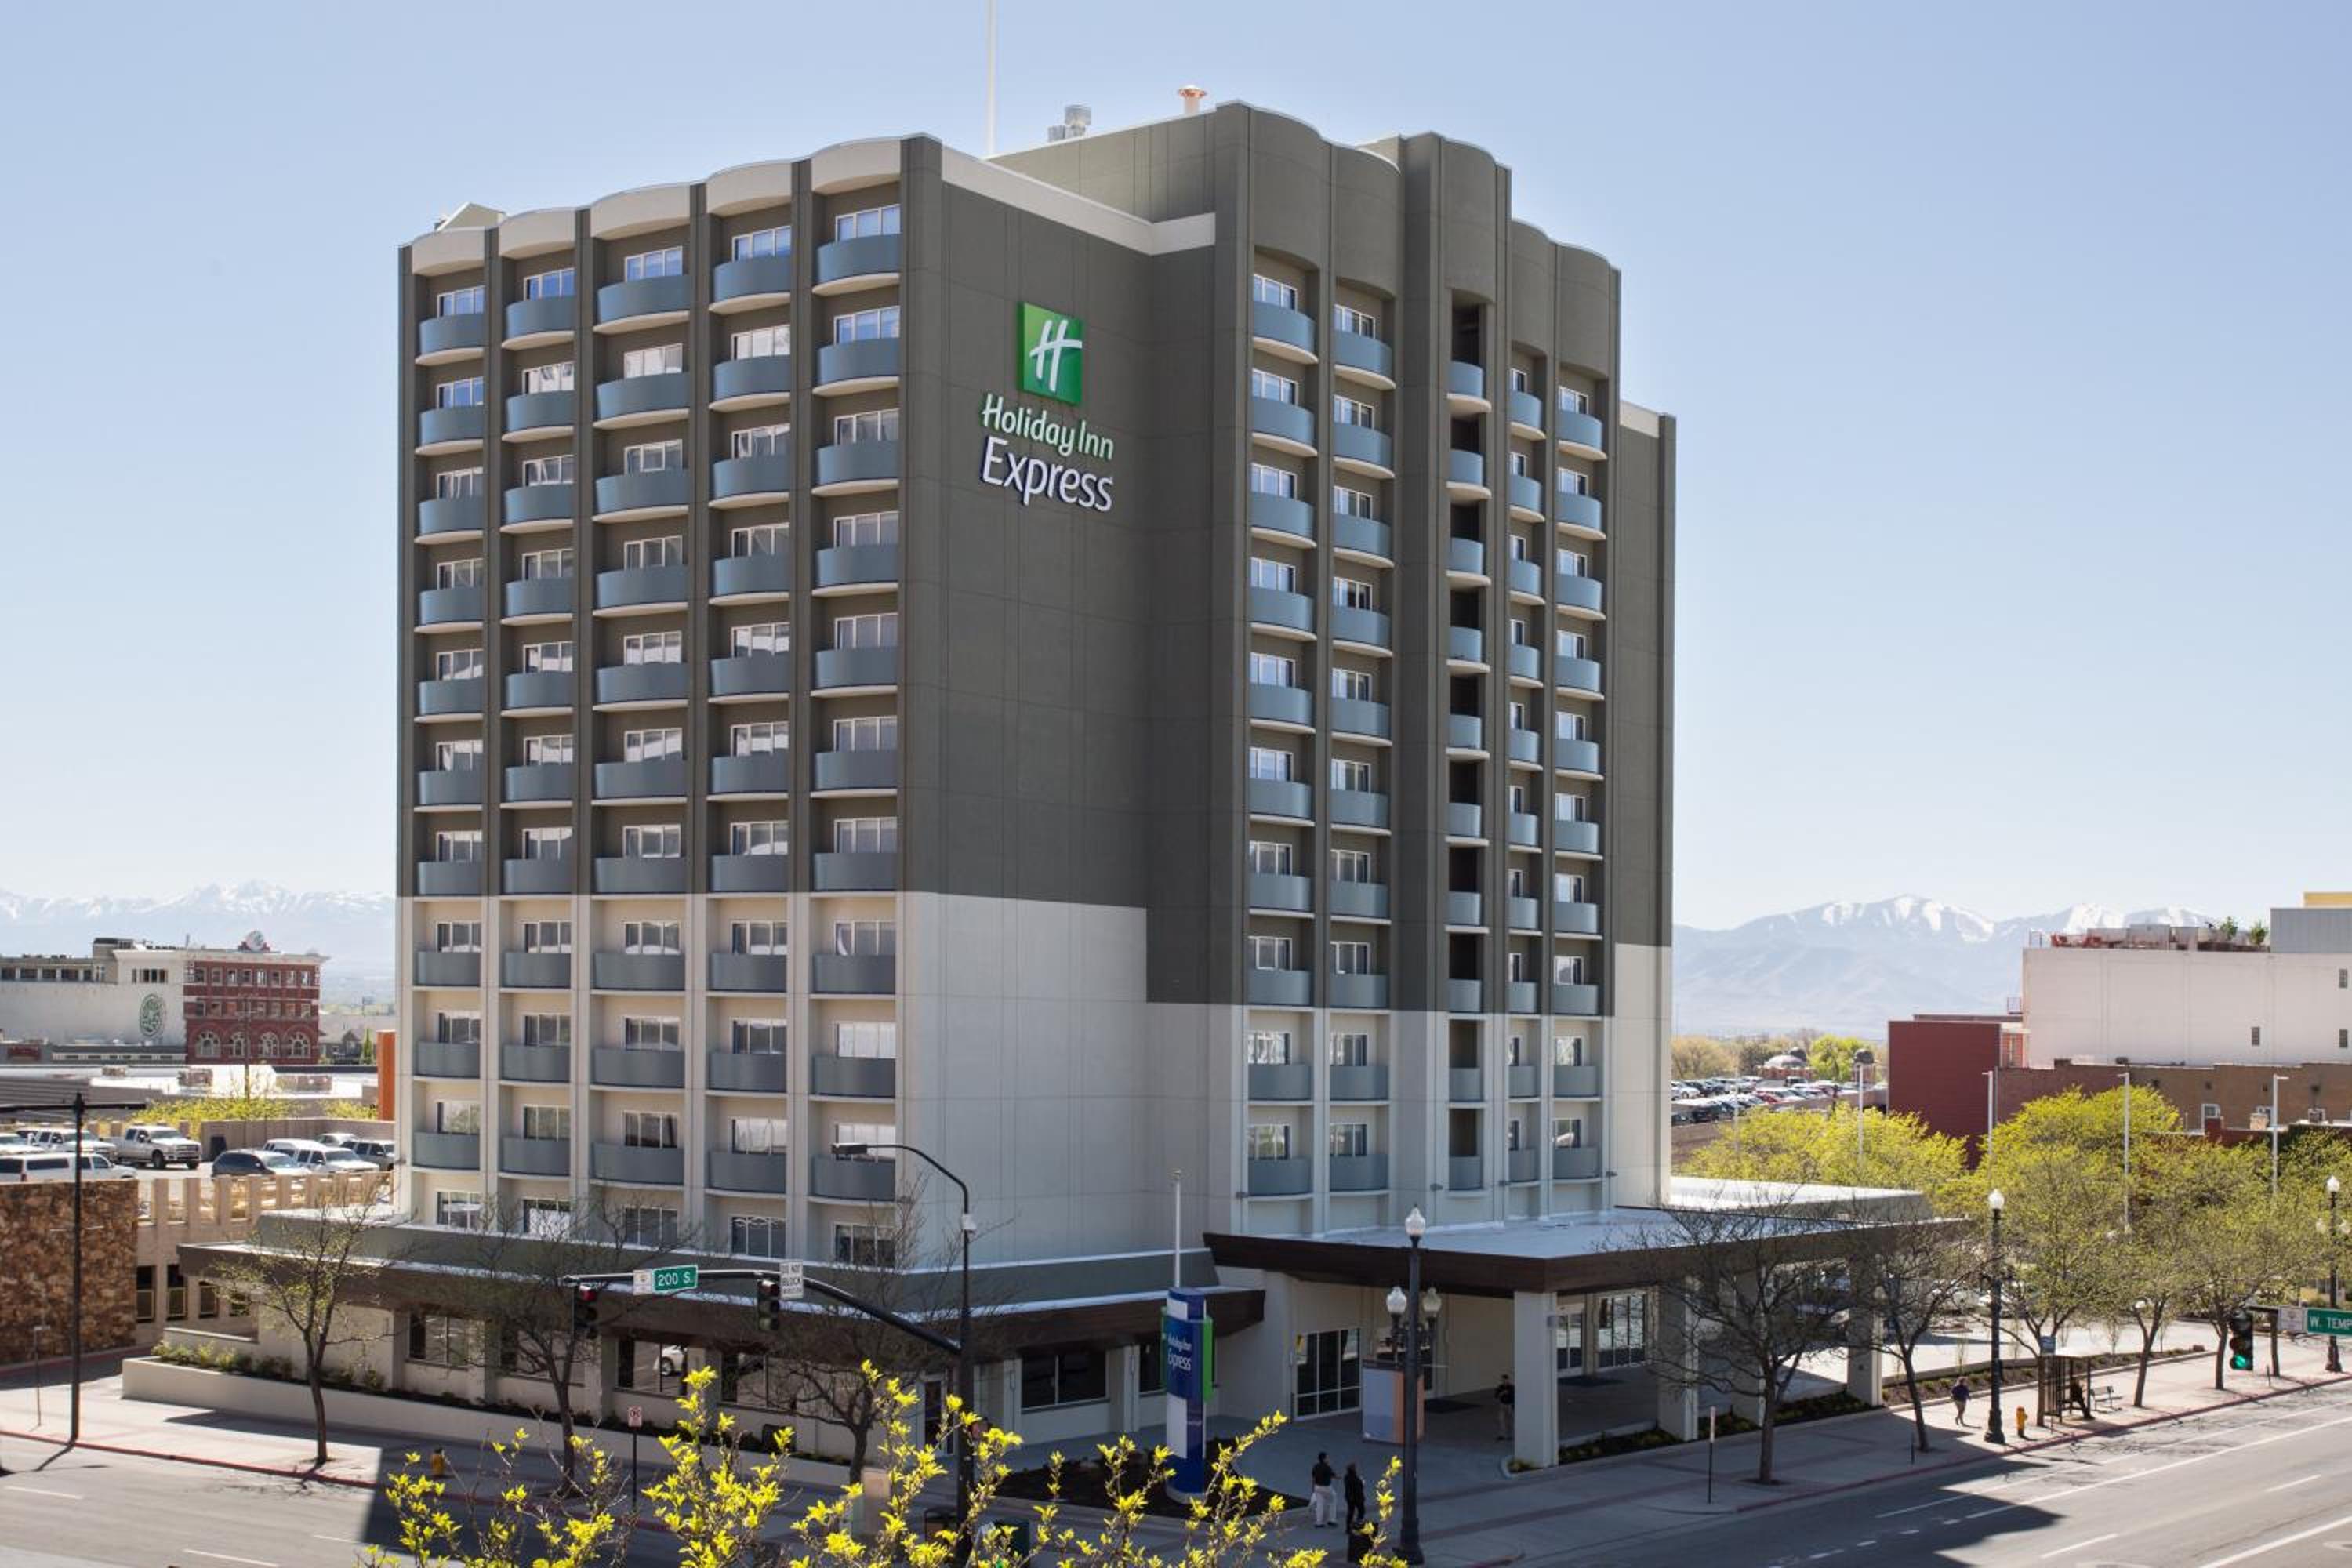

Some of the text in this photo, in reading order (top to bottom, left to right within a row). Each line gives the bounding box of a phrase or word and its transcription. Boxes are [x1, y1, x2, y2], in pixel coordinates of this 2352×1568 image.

[982, 393, 1114, 460] Holiday Inn
[982, 435, 1114, 512] Express
[658, 1272, 678, 1287] 200
[1167, 1348, 1192, 1372] Express
